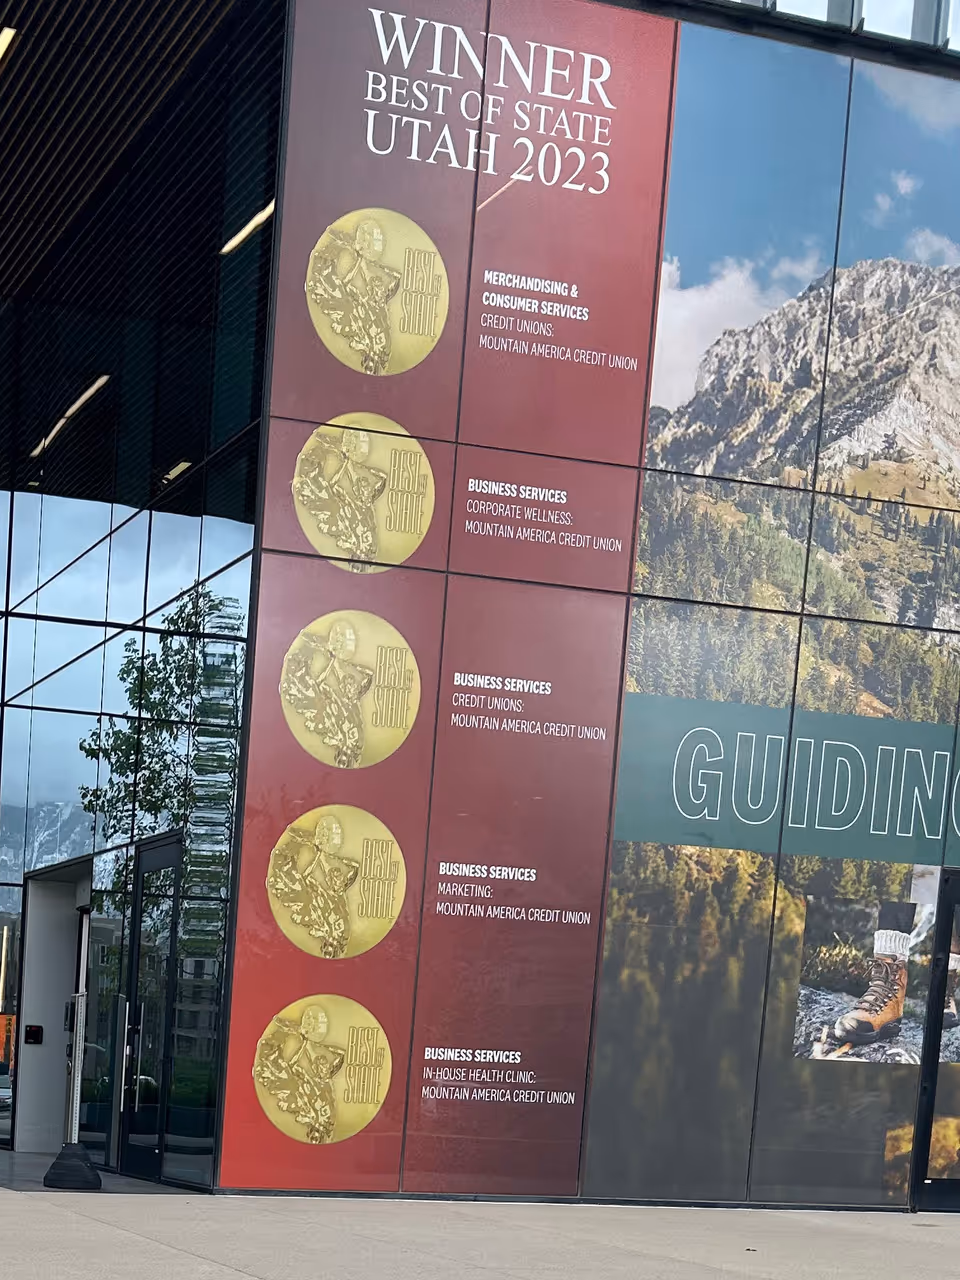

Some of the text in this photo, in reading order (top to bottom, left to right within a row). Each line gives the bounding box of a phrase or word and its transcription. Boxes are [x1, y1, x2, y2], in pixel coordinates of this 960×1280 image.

[368, 8, 617, 109] WINNER
[364, 70, 612, 147] BEST OF STATE
[364, 109, 610, 195] UTAH 2023
[403, 248, 437, 293] BEST
[484, 270, 579, 298] MERCHANDISING &
[400, 291, 440, 337] STATE
[482, 292, 589, 321] CONSUMER SERVICES
[481, 314, 554, 337] CREDIT UNIONS:
[479, 335, 638, 371] MOUNTAIN AMERICA CREDIT UNION
[390, 448, 423, 492] BEST
[468, 479, 567, 504] BUSINESS SERVICES
[386, 491, 425, 535] STATE
[466, 499, 573, 526] CORPORATE WELLNESS:
[465, 520, 622, 552] MOUNTAIN AMERICA CREDIT UNION
[376, 646, 408, 688] BEST
[454, 672, 552, 695] BUSINESS SERVICES
[372, 686, 411, 729] STATE
[452, 693, 524, 713] CREDIT UNIONS:
[450, 713, 607, 741] MOUNTAIN AMERICA CREDIT UNION
[673, 727, 960, 839] GUIDIN
[362, 839, 394, 879] BEST
[439, 862, 537, 881] BUSINESS SERVICES
[358, 879, 397, 919] STATE
[437, 882, 494, 898] MARKETING:
[436, 902, 591, 925] MOUNTAIN AMERICA CREDIT UNION
[347, 1026, 380, 1065] BEST
[424, 1047, 521, 1063] BUSINESS SERVICES
[344, 1064, 383, 1104] STATE
[423, 1067, 537, 1083] IN-HOUSE HEALTH CLINIC:
[422, 1086, 575, 1104] MOUNTAIN AMERICA CREDIT UNION
